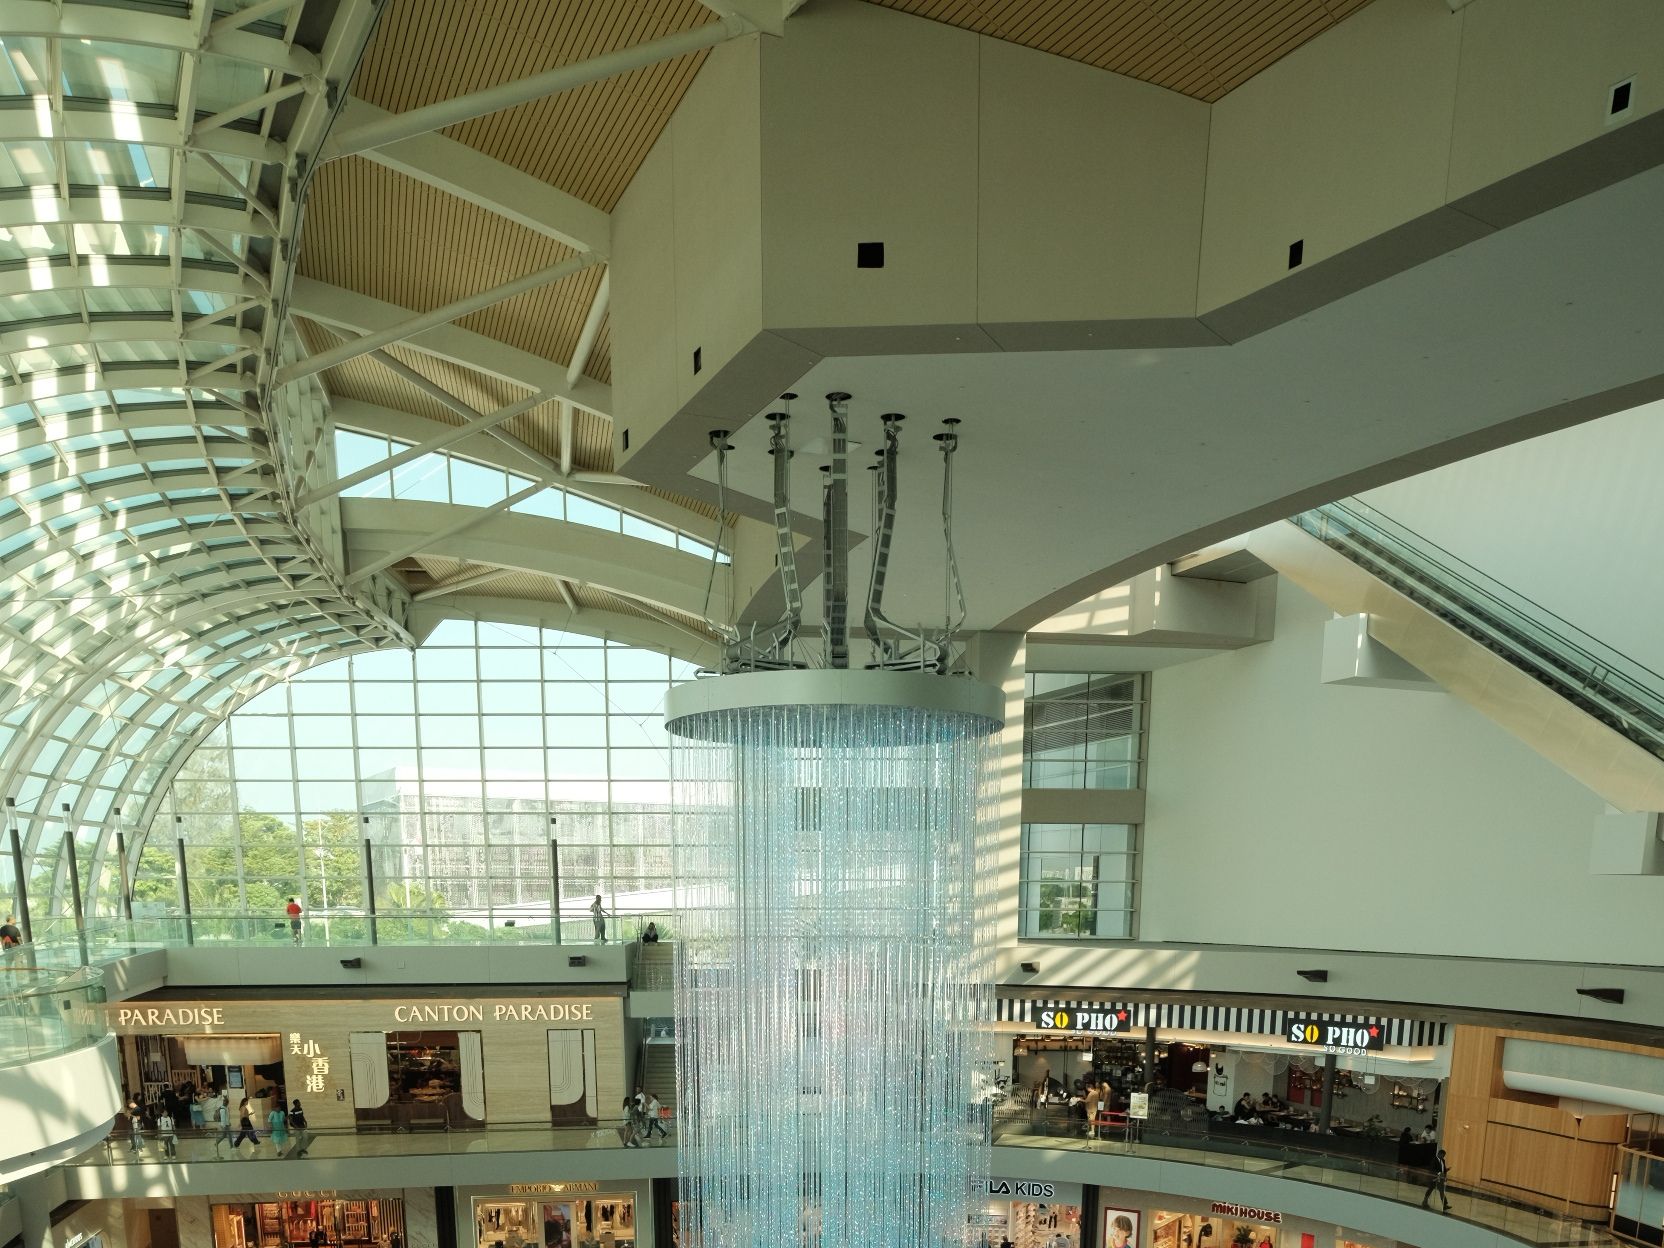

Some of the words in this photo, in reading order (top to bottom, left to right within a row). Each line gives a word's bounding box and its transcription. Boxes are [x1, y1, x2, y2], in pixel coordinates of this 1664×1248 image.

[118, 1008, 225, 1026] PARADISE
[394, 1005, 483, 1022] CANTON
[493, 1004, 593, 1021] PARADISE
[1041, 1011, 1069, 1029] SO
[1075, 1012, 1118, 1031] PHO
[289, 1032, 302, 1055] 樂天
[1291, 1023, 1319, 1043] SO
[1326, 1026, 1370, 1047] PHO
[1323, 1045, 1336, 1053] SO
[1336, 1046, 1367, 1056] GOOD
[302, 1039, 330, 1093] 小香港
[511, 1184, 552, 1193] EMPORIO
[563, 1182, 598, 1192] ARMANI
[1015, 1182, 1055, 1198] KIDS
[1239, 1207, 1283, 1224] HOUSE
